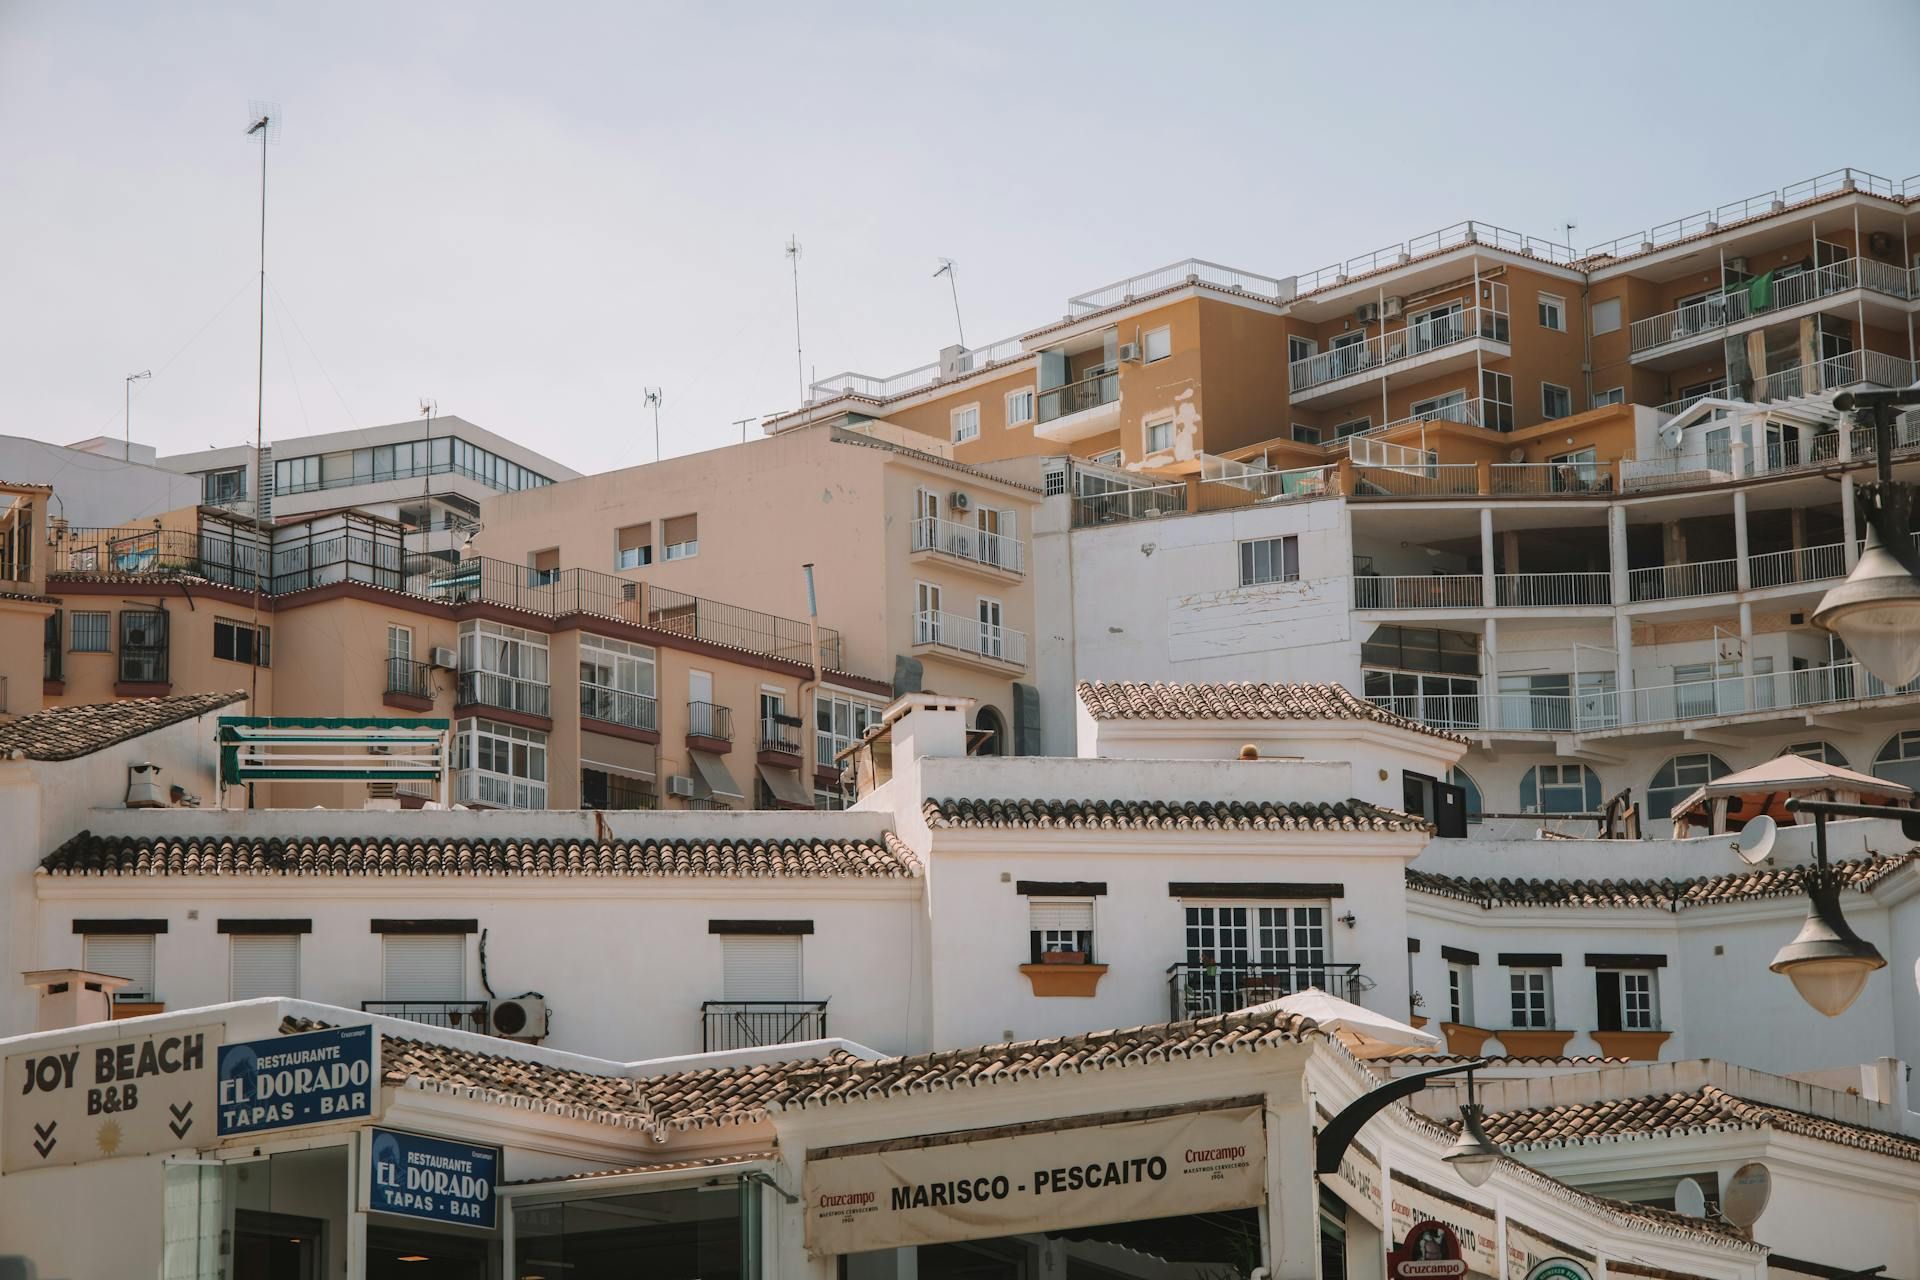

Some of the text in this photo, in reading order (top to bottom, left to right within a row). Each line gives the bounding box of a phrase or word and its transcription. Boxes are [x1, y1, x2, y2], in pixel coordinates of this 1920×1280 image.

[23, 1033, 204, 1095] JOY BEACH
[257, 1046, 341, 1070] RESTAURANTE
[220, 1060, 369, 1105] EL DORADO
[88, 1083, 138, 1116] B&B
[224, 1103, 294, 1128] TAPAS
[321, 1092, 365, 1114] BAR
[408, 1152, 472, 1173] RESTAURANTE
[1185, 1146, 1245, 1163] Cruzcampo
[377, 1162, 489, 1201] EL DORADO
[891, 1175, 1009, 1211] MARISCO
[1034, 1156, 1167, 1195] PESCAITO
[384, 1190, 433, 1211] TAPAS
[450, 1201, 480, 1218] BAR
[820, 1192, 874, 1208] Cruzcampo
[1403, 1264, 1459, 1274] Cruzcampo
